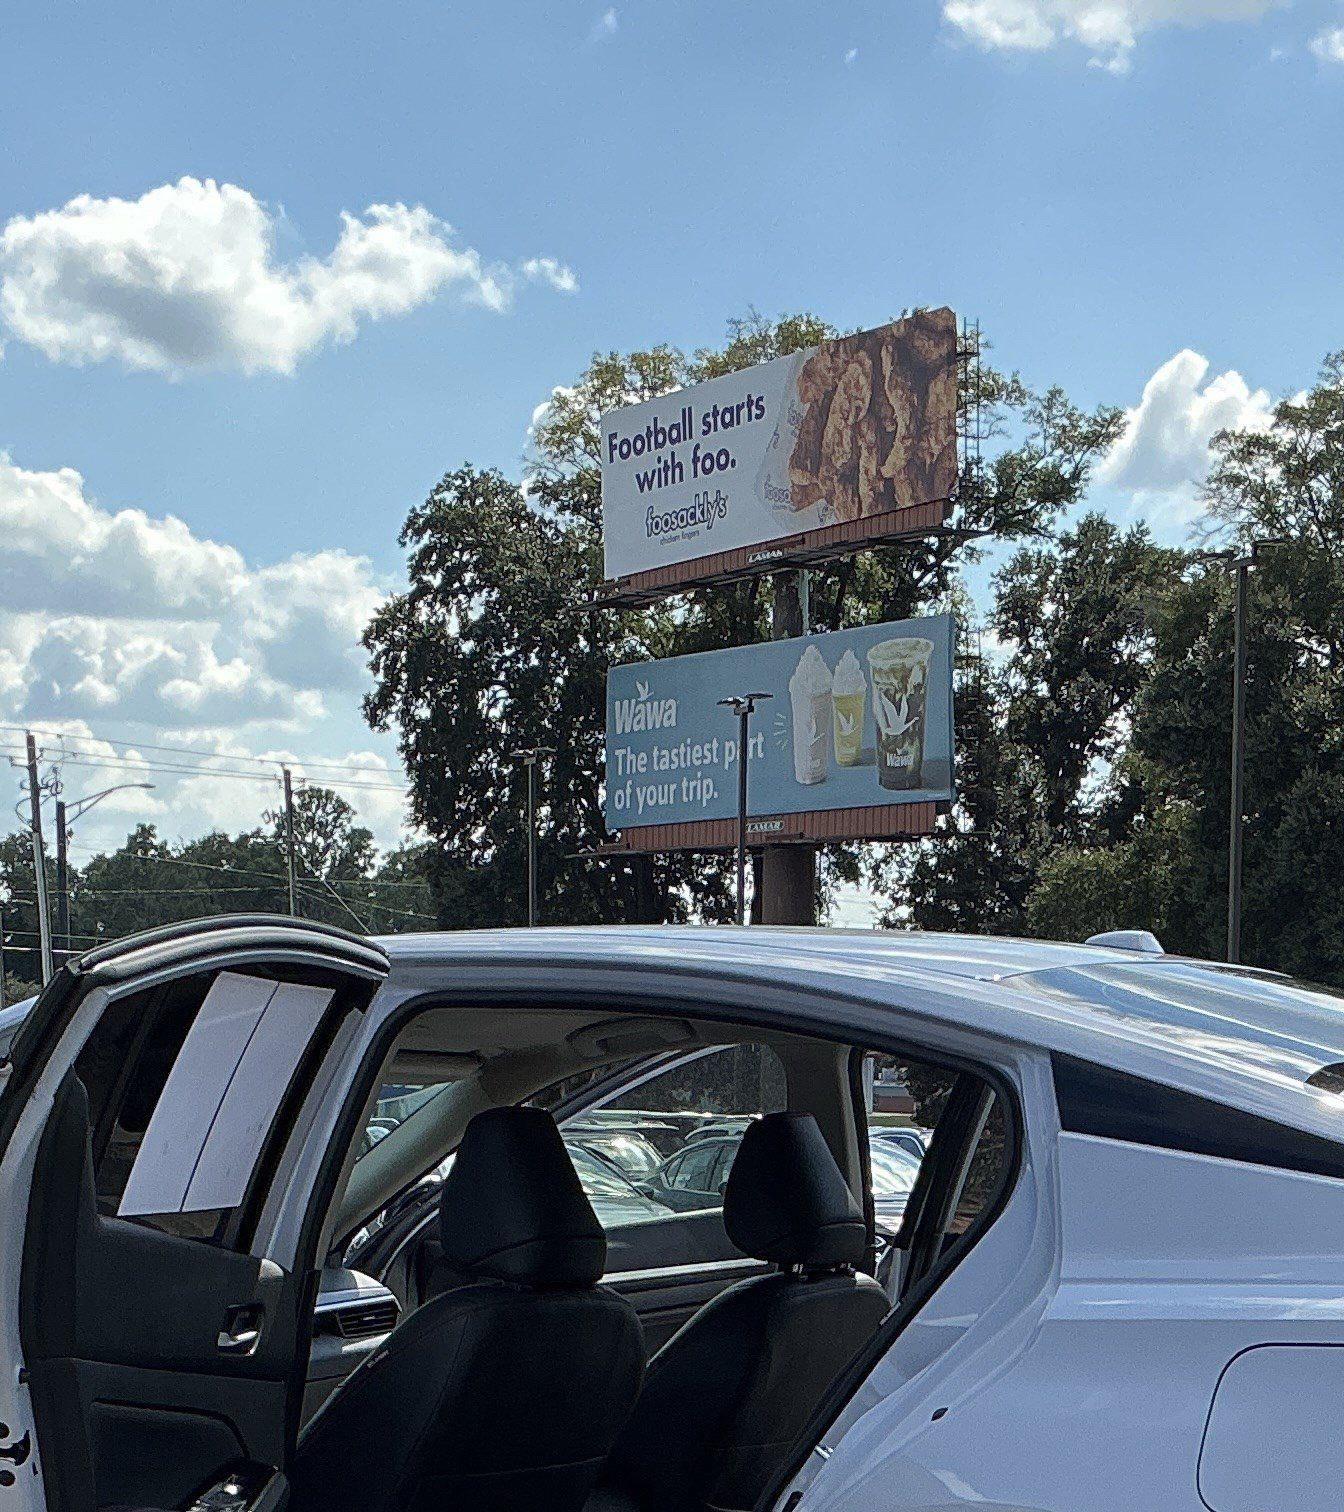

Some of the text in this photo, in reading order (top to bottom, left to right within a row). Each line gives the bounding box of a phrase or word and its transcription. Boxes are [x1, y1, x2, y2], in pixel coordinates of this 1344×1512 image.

[608, 406, 693, 464] Football
[701, 394, 766, 436] starts
[635, 442, 736, 494] with foo.
[645, 490, 728, 538] foosackly's
[614, 698, 677, 735] Wawa
[614, 732, 765, 776] The tastiest prt
[614, 771, 719, 815] of your trip.
